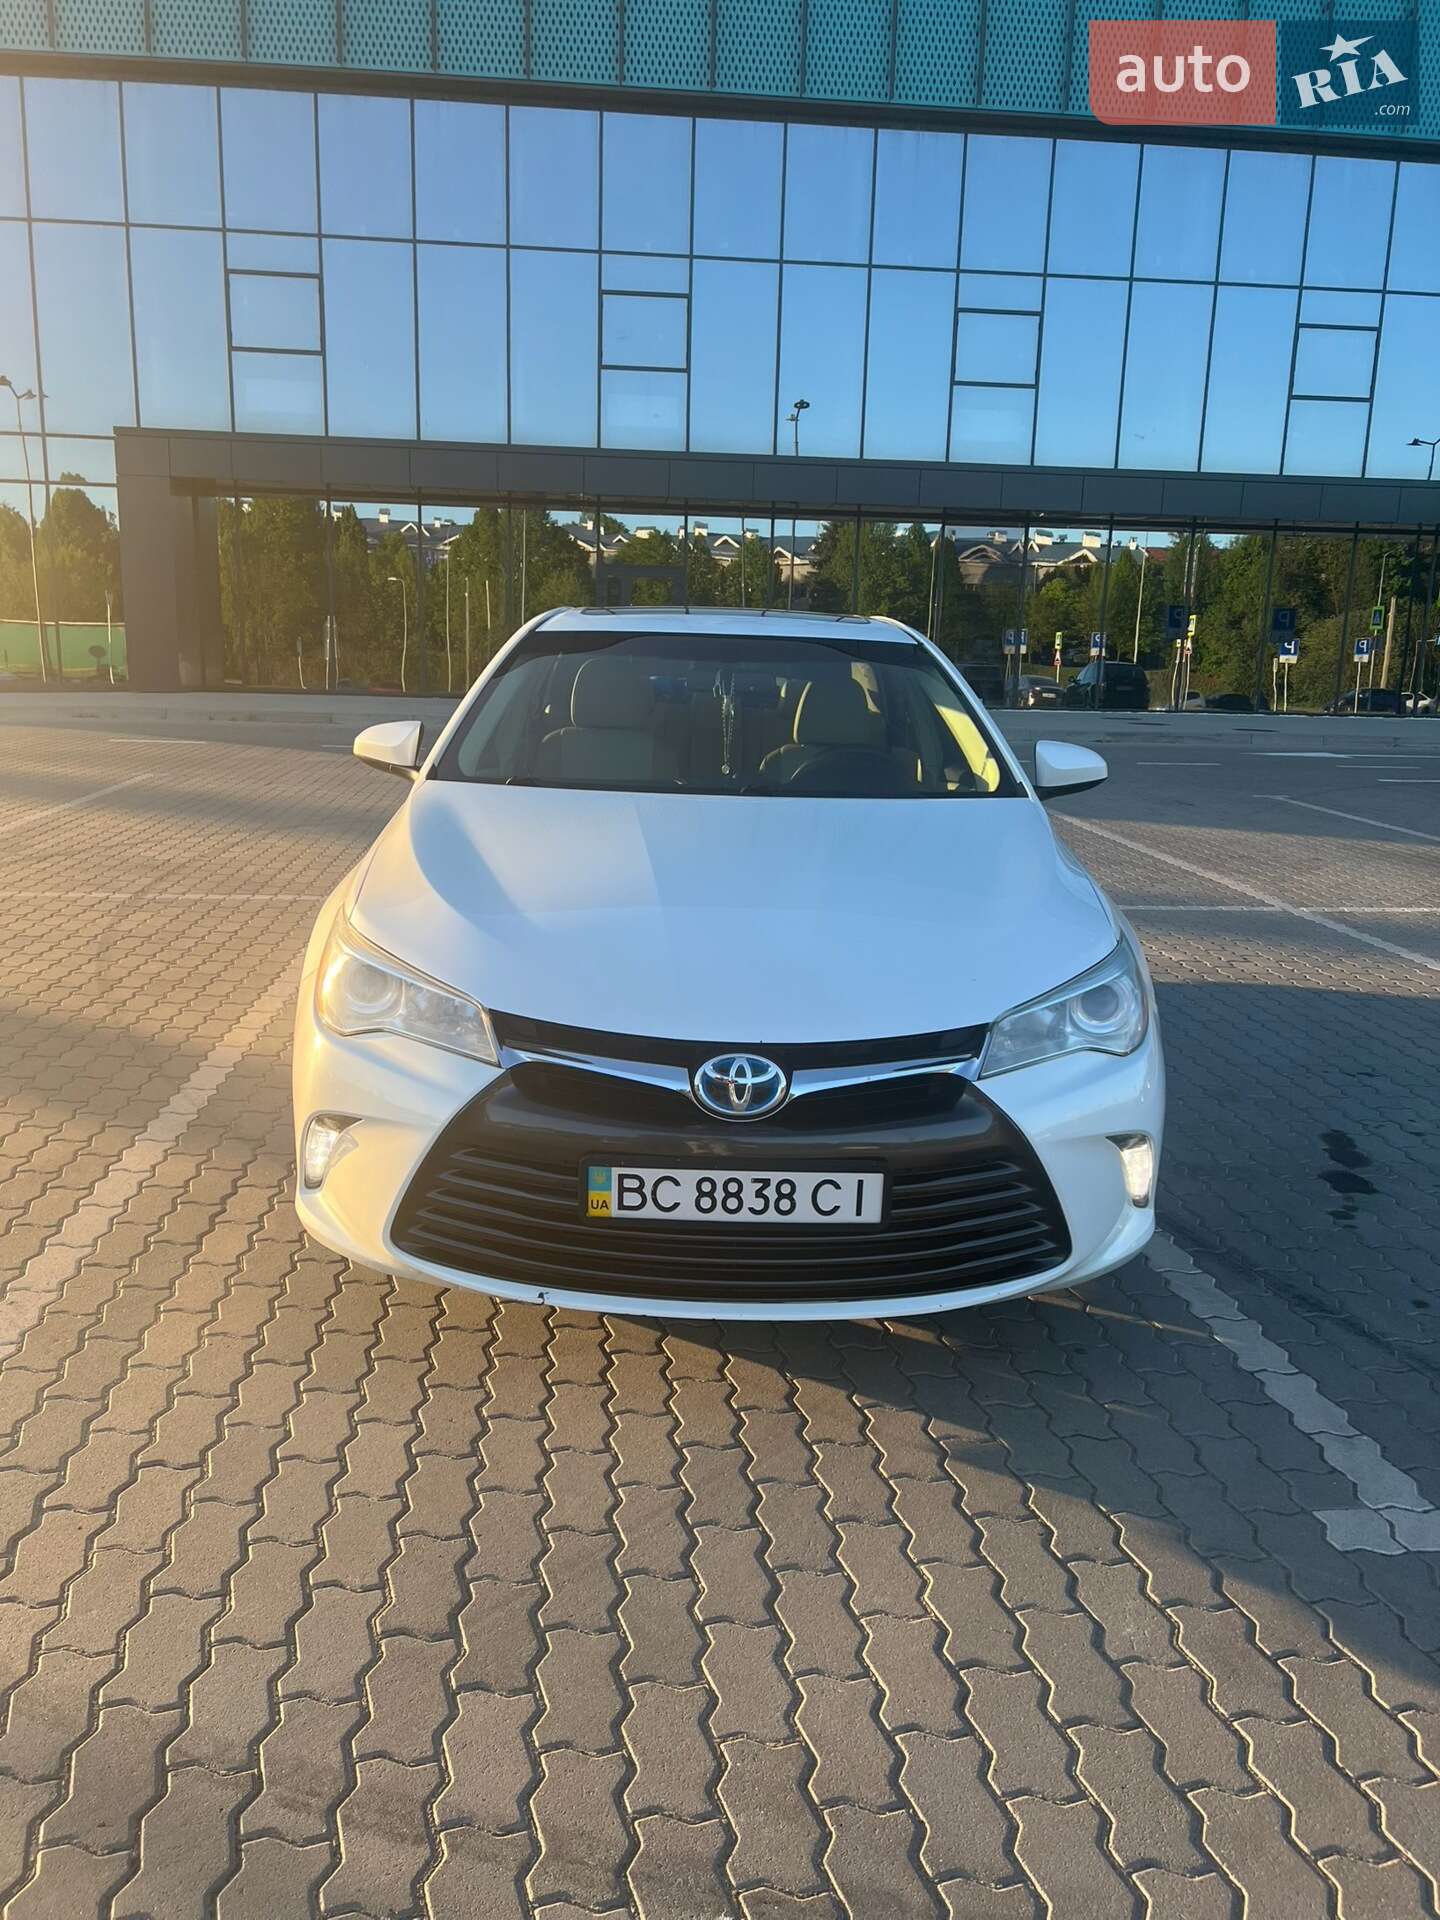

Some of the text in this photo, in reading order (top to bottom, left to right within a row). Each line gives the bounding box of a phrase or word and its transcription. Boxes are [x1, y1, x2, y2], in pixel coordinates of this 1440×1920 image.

[590, 1200, 609, 1211] UA
[617, 1173, 865, 1218] BC 8838 CI
